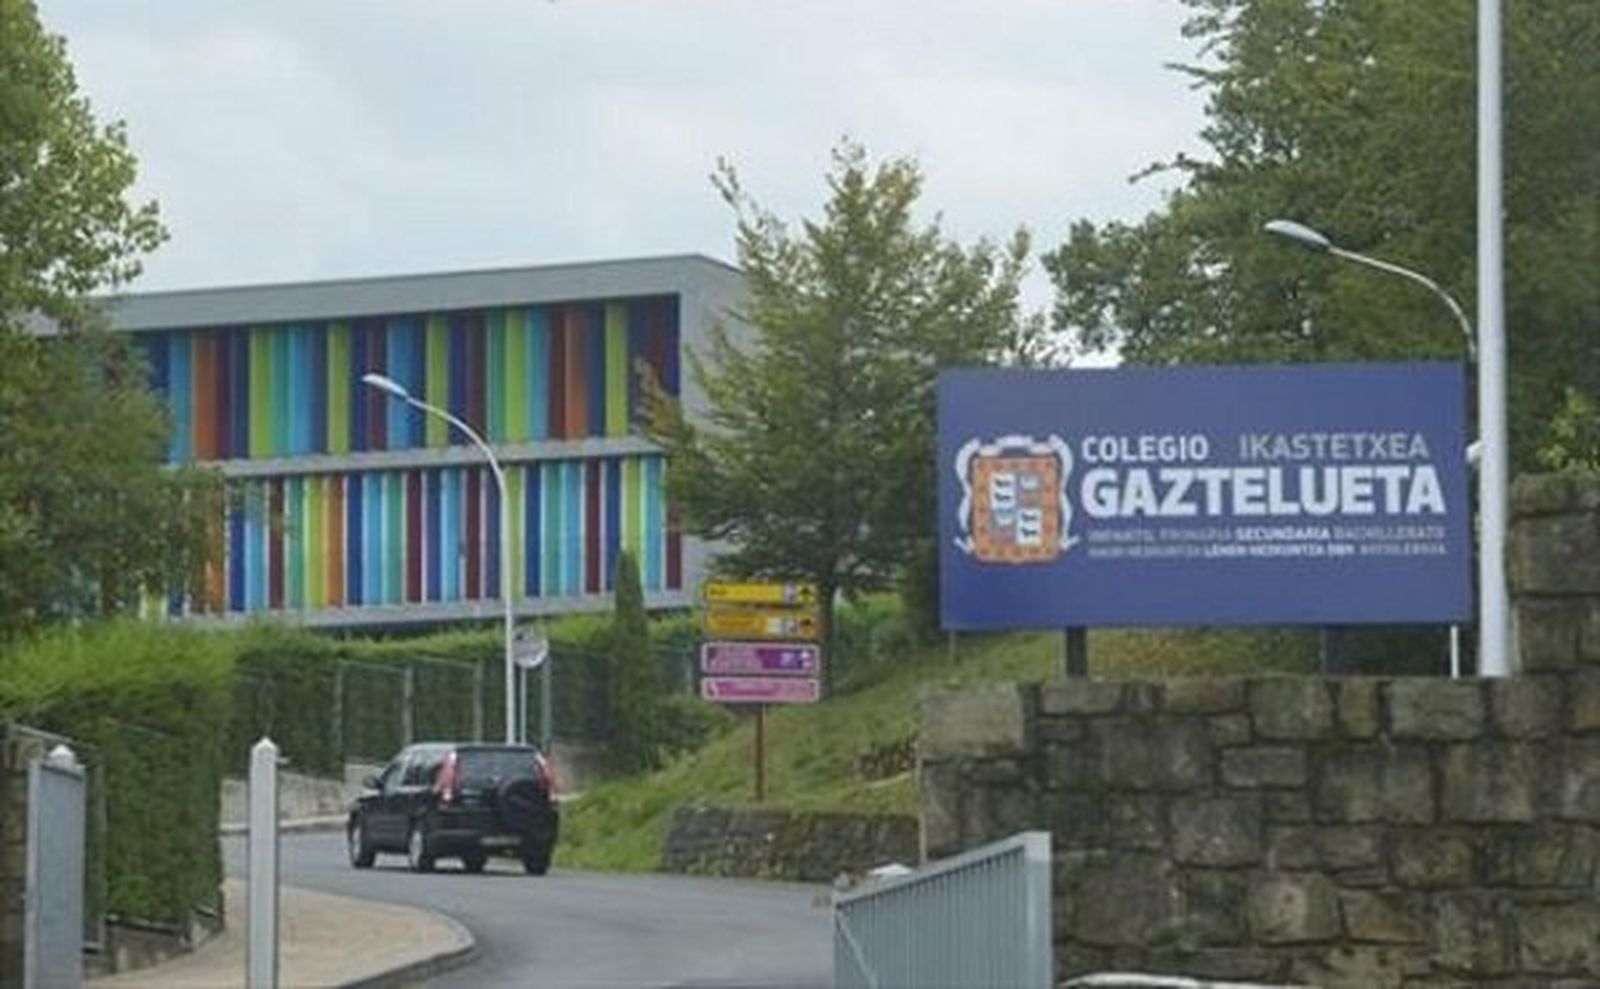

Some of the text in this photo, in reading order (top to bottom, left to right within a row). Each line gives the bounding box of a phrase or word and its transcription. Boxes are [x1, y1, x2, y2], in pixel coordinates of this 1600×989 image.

[1081, 433, 1430, 462] COLEGIO IKASTETXEA
[1080, 465, 1447, 517] GAZTELUETA
[1233, 525, 1331, 541] SECUNDARIA
